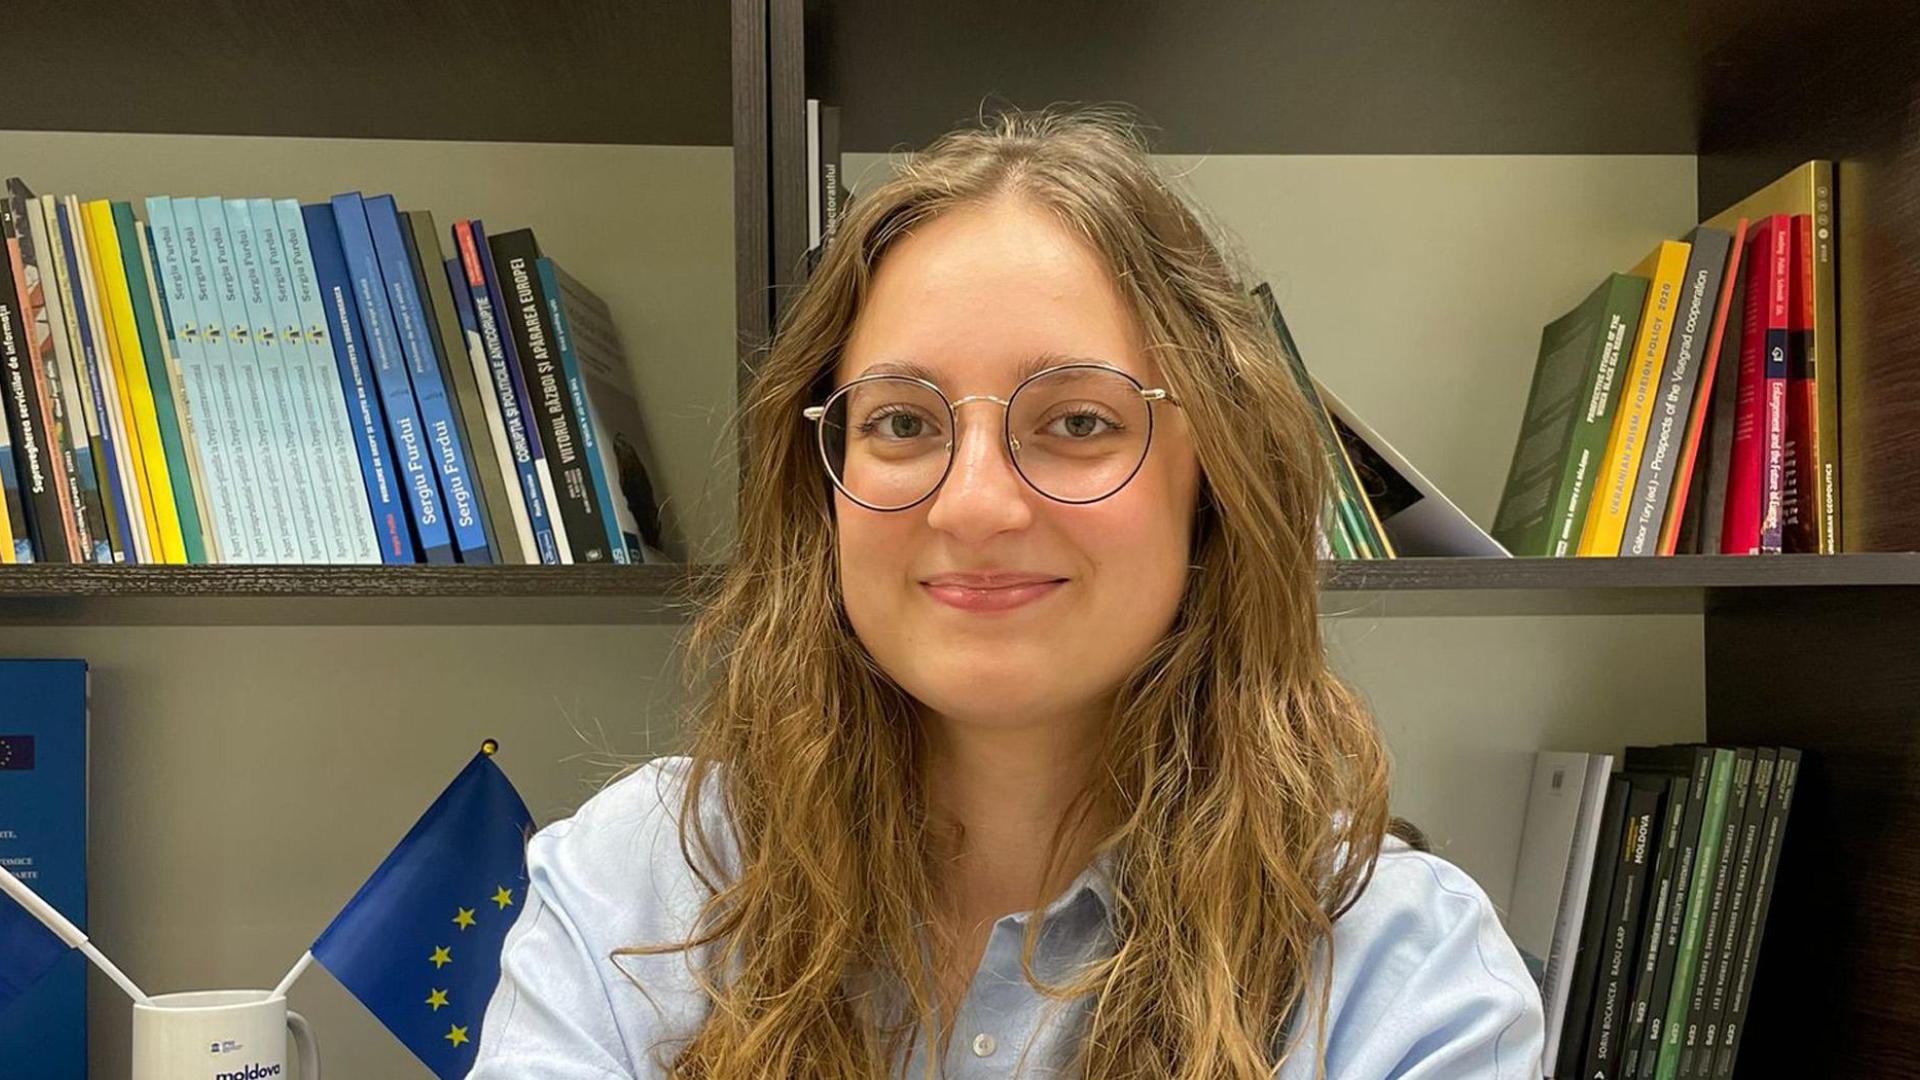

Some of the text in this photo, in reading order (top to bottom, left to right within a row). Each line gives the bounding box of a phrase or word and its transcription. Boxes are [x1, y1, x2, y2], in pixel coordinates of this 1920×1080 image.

[159, 225, 177, 263] Furdui
[183, 226, 209, 301] Sergiu Furdui
[211, 226, 236, 301] Sergiu Furdui
[237, 229, 262, 304] Sergiu Furdui
[263, 227, 288, 303] Sergiu Furdui
[287, 227, 311, 302] Sergiu Furdui
[170, 264, 185, 301] Sergiu
[510, 257, 534, 304] EUROPEI
[1685, 269, 1708, 333] cooperation
[522, 304, 548, 359] APĂRAREA
[7, 356, 19, 370] de
[1671, 333, 1693, 382] Visegrad
[11, 370, 29, 419] serviciilor
[493, 360, 515, 408] POLITICILE
[540, 373, 562, 414] RĂZBOI
[1609, 452, 1631, 515] UKRAINIAN
[1634, 359, 1653, 410] FOREIGN
[1646, 316, 1663, 358] POLICY
[1657, 282, 1671, 311] 2020
[1664, 402, 1676, 415] of
[1667, 383, 1681, 402] the
[1769, 381, 1783, 433] Enlargement
[22, 419, 44, 493] Supravegherea
[552, 413, 575, 463] VIITORUL
[1650, 416, 1673, 471] Prospects
[1770, 432, 1781, 449] and
[1770, 449, 1781, 464] the
[396, 417, 436, 525] Sergiu Furdui
[432, 420, 473, 527] Sergiu Furdui
[1769, 464, 1781, 491] Future
[1824, 463, 1834, 555] UNGARIAN GEOPOLITICS
[1634, 814, 1650, 864] MOLDOVA
[1597, 925, 1625, 1059] SORIN BOCANCEA RADU CARP
[216, 1063, 280, 1080] moldova
